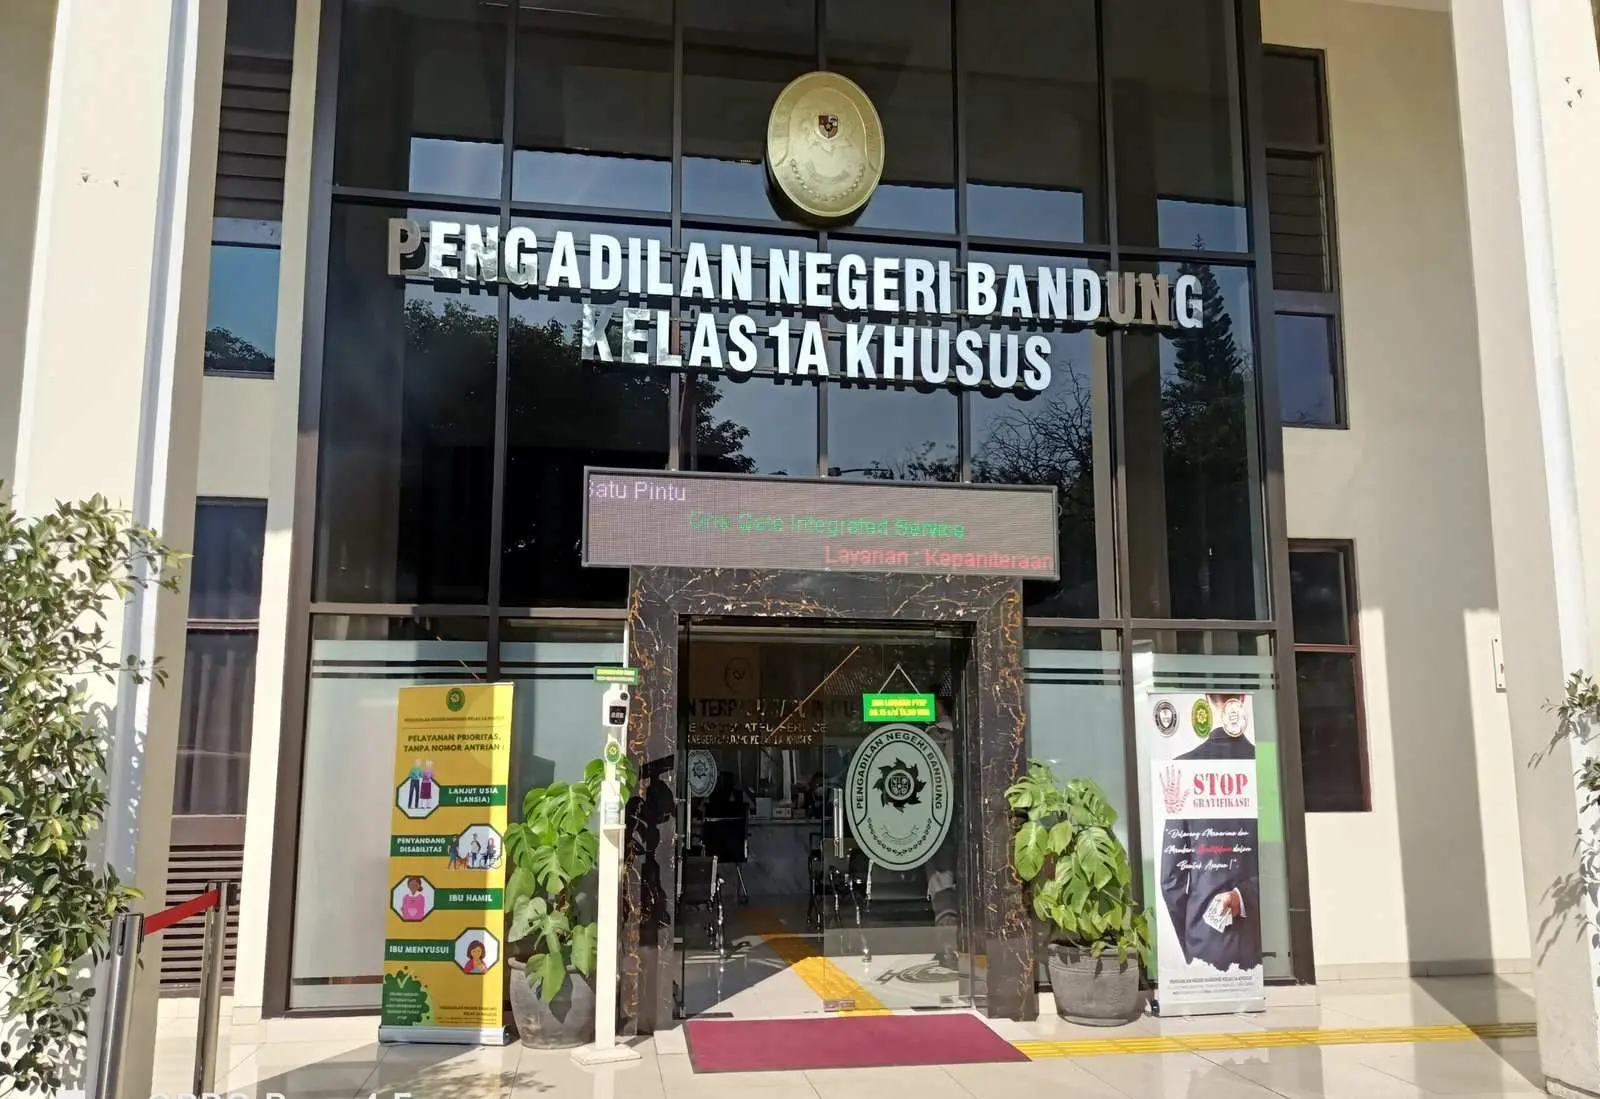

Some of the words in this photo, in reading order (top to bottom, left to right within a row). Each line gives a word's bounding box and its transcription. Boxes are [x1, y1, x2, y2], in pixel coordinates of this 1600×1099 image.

[387, 217, 753, 302] PENGADILAN
[769, 247, 952, 315] NEGERI
[967, 261, 1204, 329] BANDUNG
[581, 303, 758, 373] KELAS
[768, 317, 830, 377] 1A
[846, 323, 1052, 391] KHUSUS
[634, 480, 686, 501] Pintu
[407, 733, 457, 742] PELAYANAN
[403, 744, 430, 753] TANPA
[431, 743, 462, 753] NOMOR
[463, 742, 500, 752] ANTRIAN
[856, 738, 884, 809] PENGADILAN
[885, 731, 929, 752] NEGERI
[926, 751, 943, 810] BANDUNG
[1193, 772, 1249, 796] STOP
[448, 786, 476, 795] LANJUT
[479, 786, 499, 794] USIA
[455, 795, 491, 804] (LANSIA)
[396, 836, 446, 845] PENYANDANG
[399, 845, 443, 854] DISABILITAS
[448, 893, 464, 903] IBU
[465, 893, 493, 903] HAMIL
[389, 944, 404, 954] IBU
[405, 944, 449, 955] MENYUSUI
